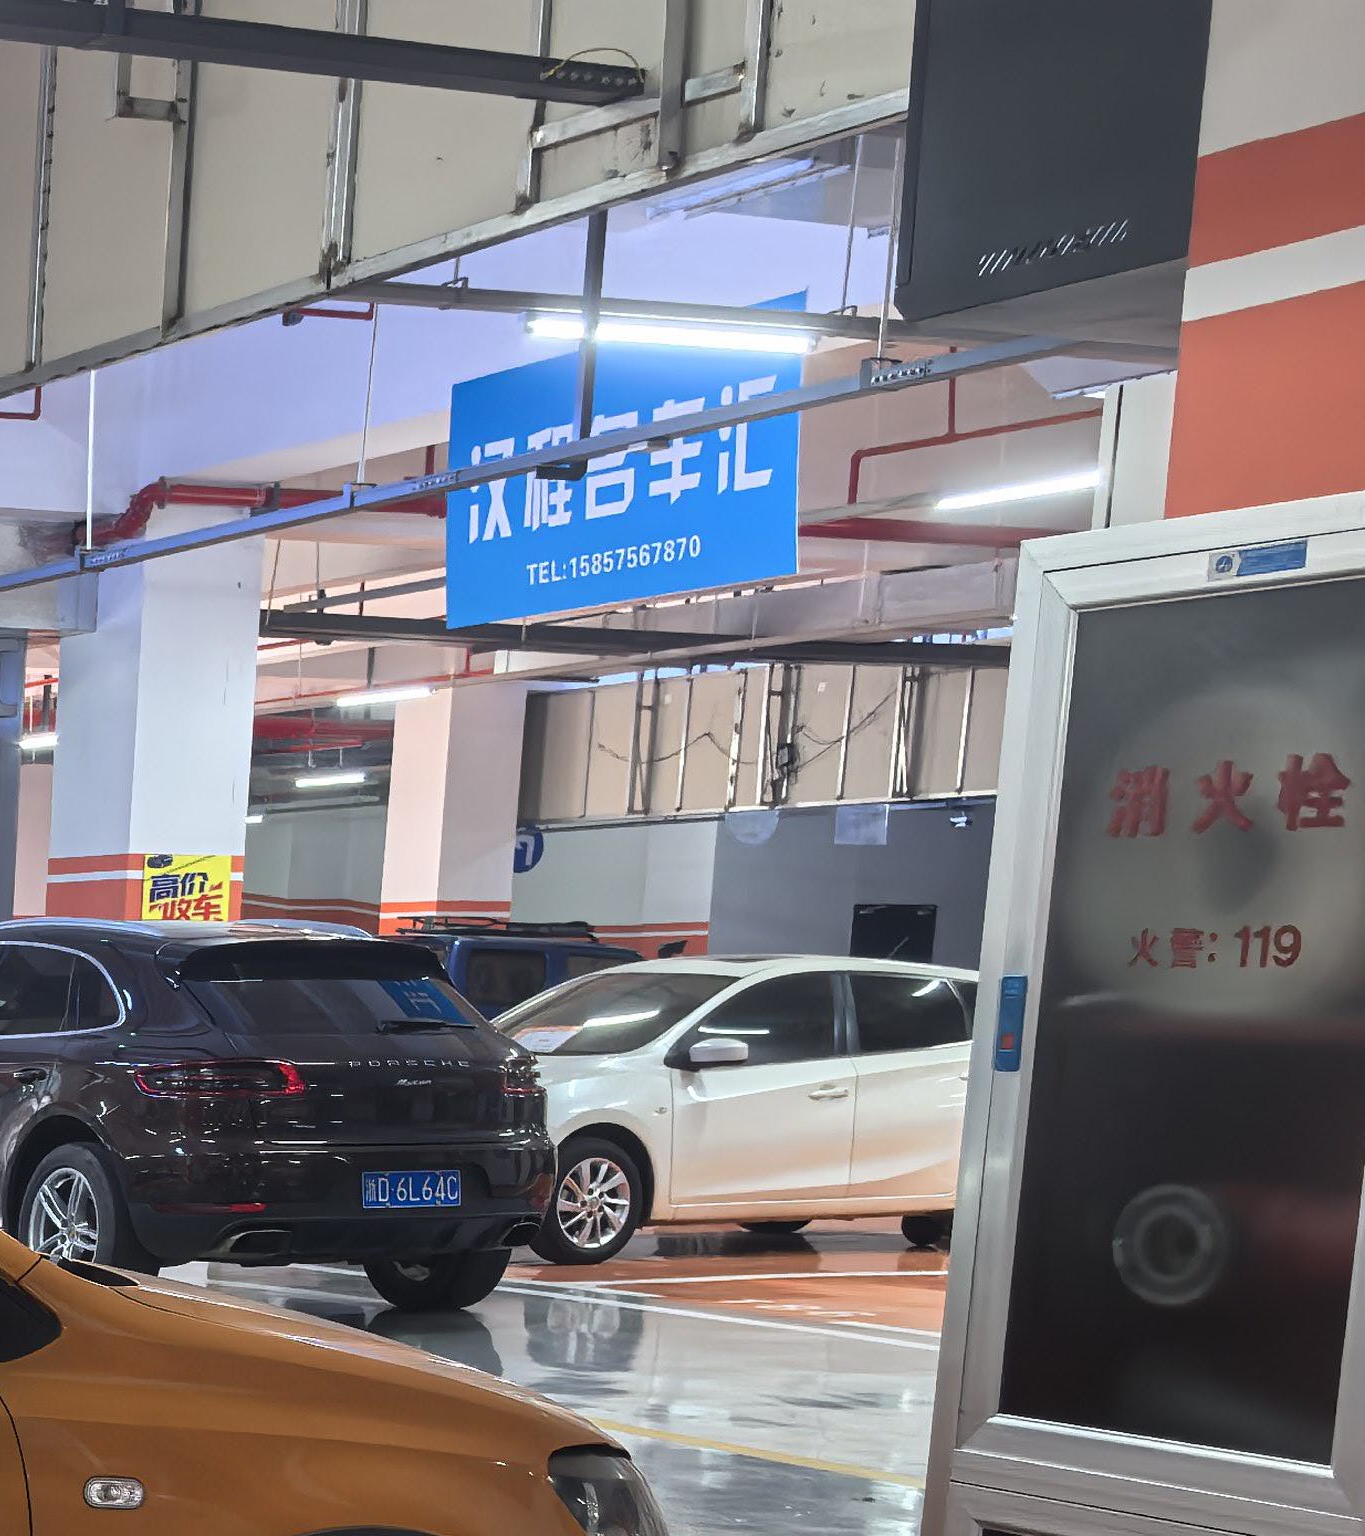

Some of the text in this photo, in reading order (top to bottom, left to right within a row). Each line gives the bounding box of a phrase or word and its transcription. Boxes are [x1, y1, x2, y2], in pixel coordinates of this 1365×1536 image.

[526, 535, 702, 586] TEL:15857567870
[1107, 752, 1352, 838] 消火栓
[148, 872, 209, 903] 高价
[148, 892, 224, 921] 收车
[348, 1059, 470, 1068] PORSCHE
